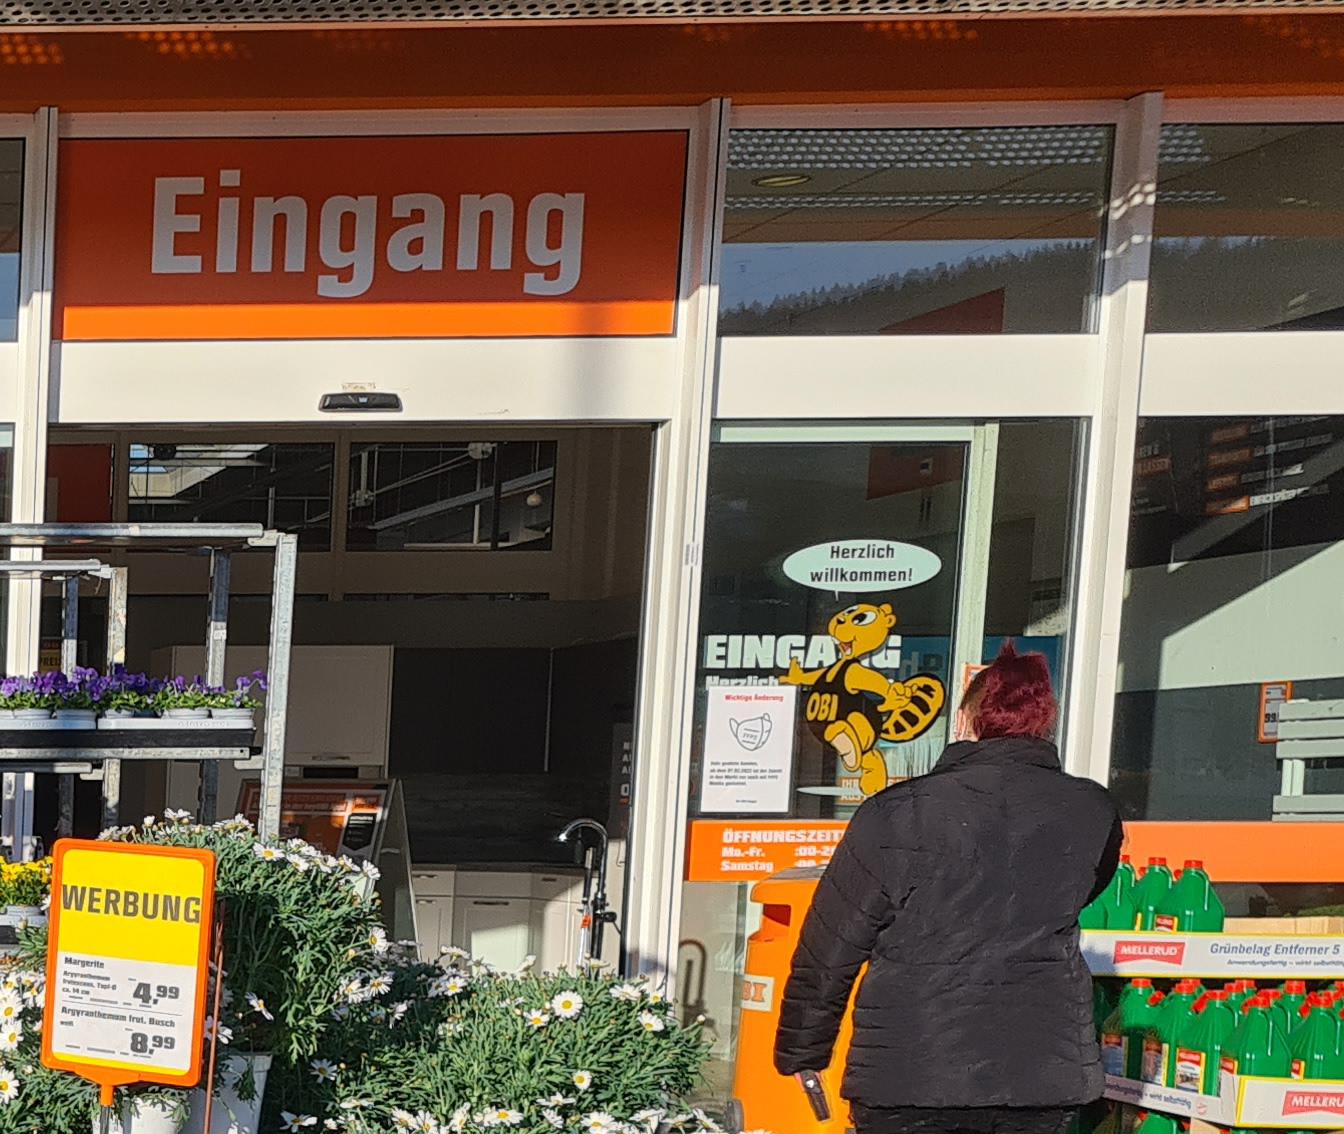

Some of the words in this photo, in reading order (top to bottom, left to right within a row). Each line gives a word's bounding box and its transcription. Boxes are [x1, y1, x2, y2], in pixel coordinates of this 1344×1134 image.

[151, 169, 586, 298] Eingang
[831, 545, 894, 559] Herzlich
[810, 568, 913, 582] willkommen!
[705, 634, 902, 669] EINGAG
[807, 691, 839, 722] OBI
[720, 860, 773, 872] Samstag
[62, 884, 201, 924] WERBUNG
[1120, 944, 1178, 957] MELLERUD
[1210, 942, 1271, 957] Grünbelag
[1274, 943, 1330, 955] Entferner
[133, 982, 180, 1005] 4,99
[149, 1017, 176, 1028] Busch
[130, 1032, 176, 1055] 8,99
